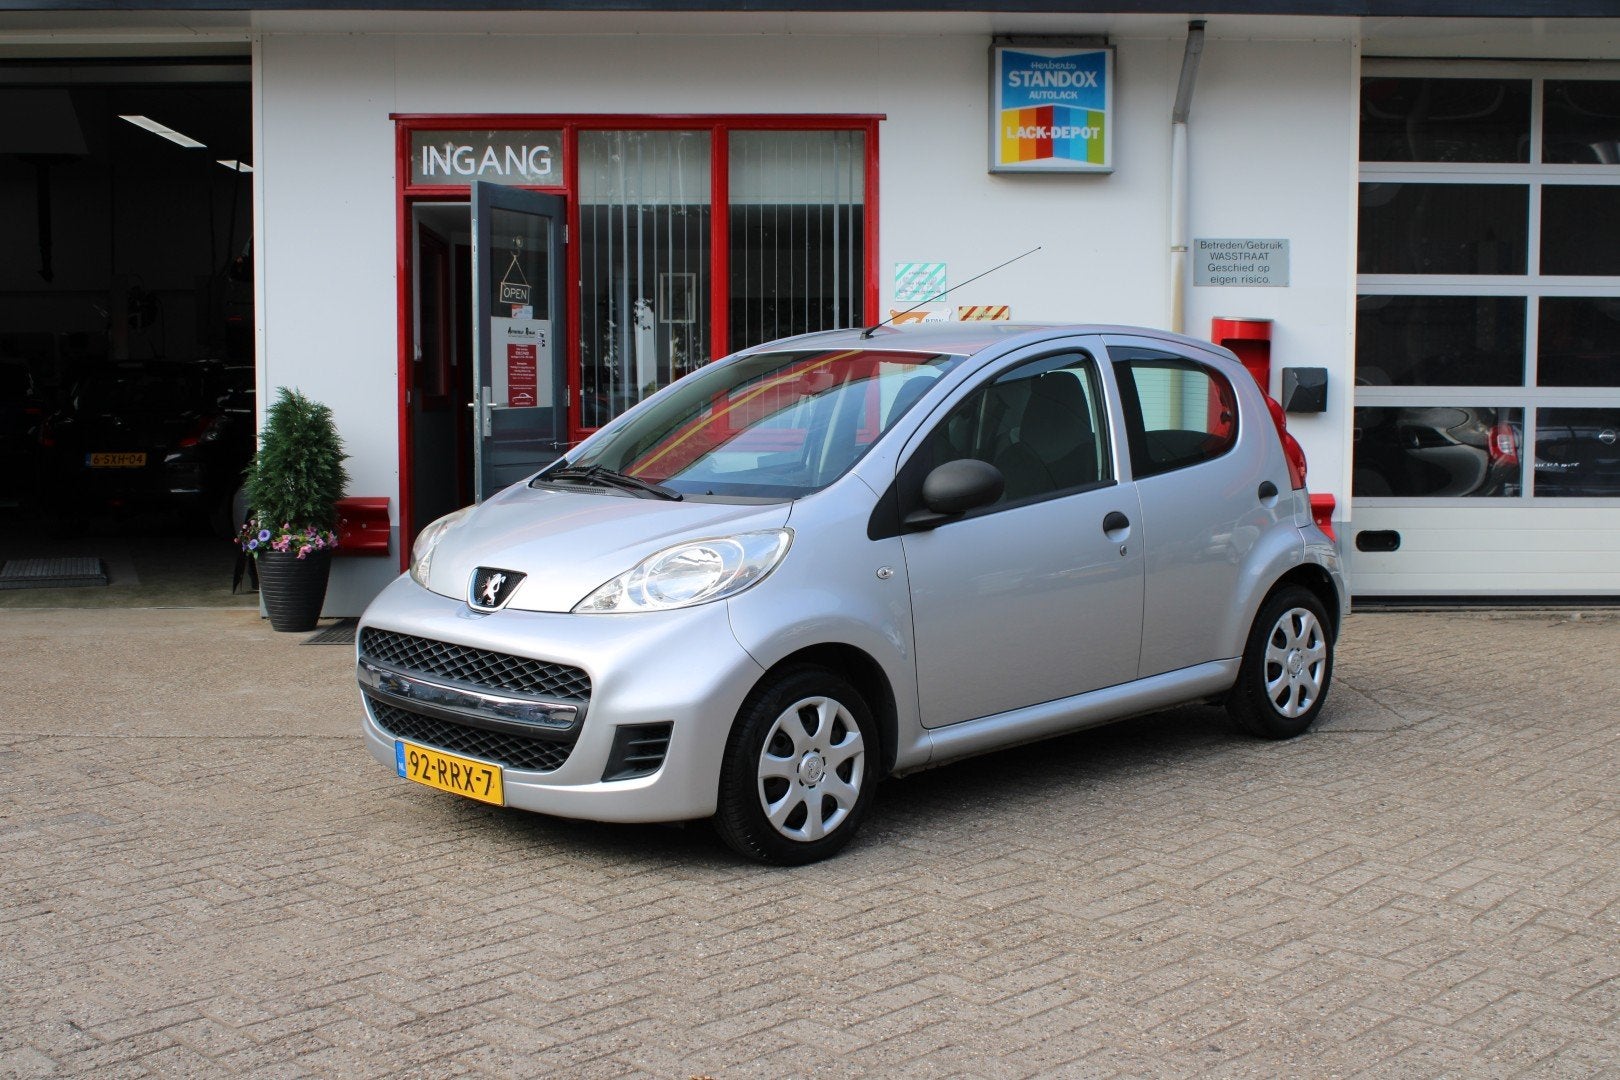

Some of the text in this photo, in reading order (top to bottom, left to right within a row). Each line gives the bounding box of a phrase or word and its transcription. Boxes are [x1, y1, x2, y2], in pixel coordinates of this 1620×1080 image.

[1031, 60, 1077, 70] Herberts
[1008, 70, 1098, 87] STANDOX
[1028, 90, 1078, 99] AUTOLACK
[1006, 126, 1100, 139] LACK-DEPOT
[422, 145, 551, 176] INGANG
[1200, 240, 1283, 250] Betreden/Gebruik
[1209, 252, 1269, 261] WASSTRAAT
[1207, 263, 1270, 273] Geschied op
[1210, 276, 1271, 286] eigen risico.
[503, 287, 528, 300] OPEN
[93, 454, 143, 465] 6-SXH-04
[409, 750, 493, 796] 92-RRX-7
